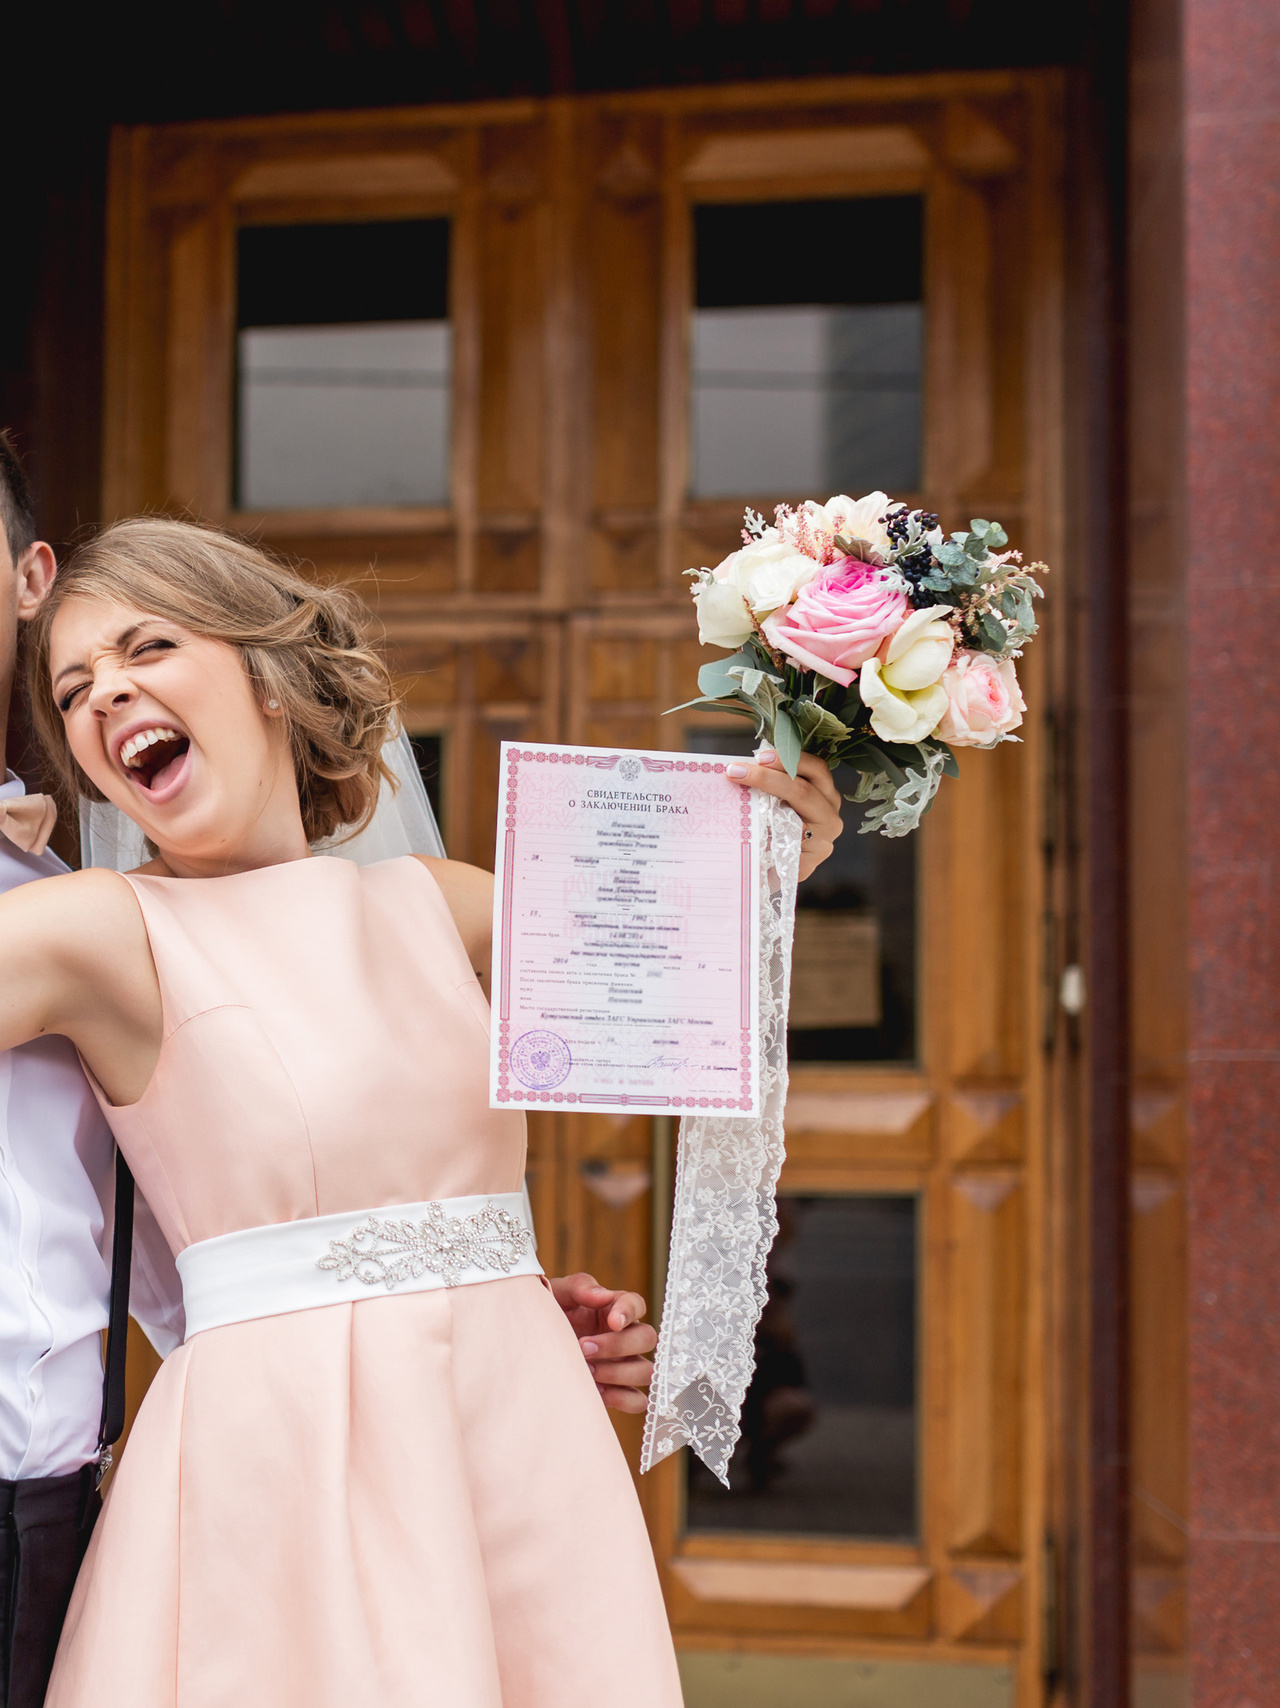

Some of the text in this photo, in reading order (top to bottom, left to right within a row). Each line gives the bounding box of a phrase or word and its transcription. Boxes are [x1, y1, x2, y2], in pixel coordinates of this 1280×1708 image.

[587, 789, 672, 803] СВИДЕТЕЛЬСТВО
[568, 799, 689, 815] О ЗАКЛЮЧЕНИИ БРАКА
